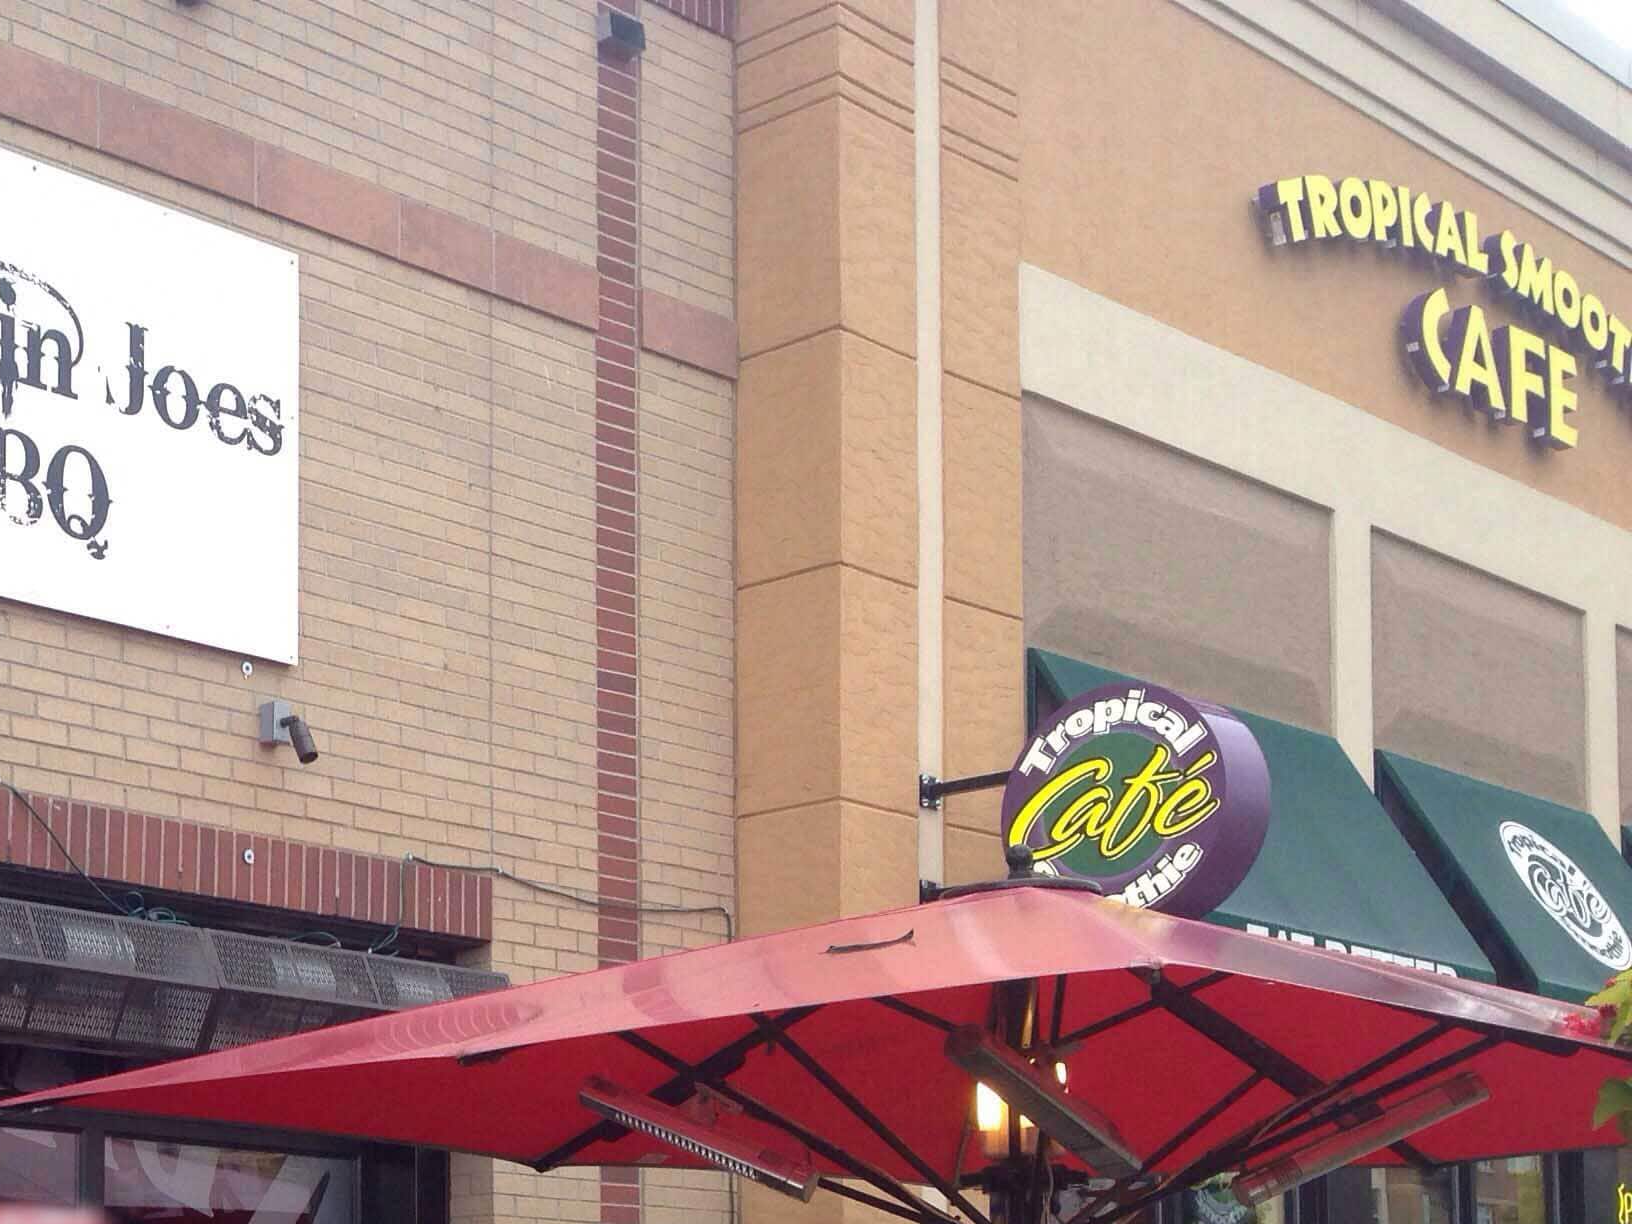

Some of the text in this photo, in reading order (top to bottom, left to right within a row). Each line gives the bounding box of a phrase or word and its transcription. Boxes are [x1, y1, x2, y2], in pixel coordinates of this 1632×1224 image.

[1277, 174, 1632, 384] TROPICAL SMOOT
[98, 320, 284, 456] Joes
[1421, 288, 1579, 448] CAFE
[1019, 687, 1209, 777] Tropical
